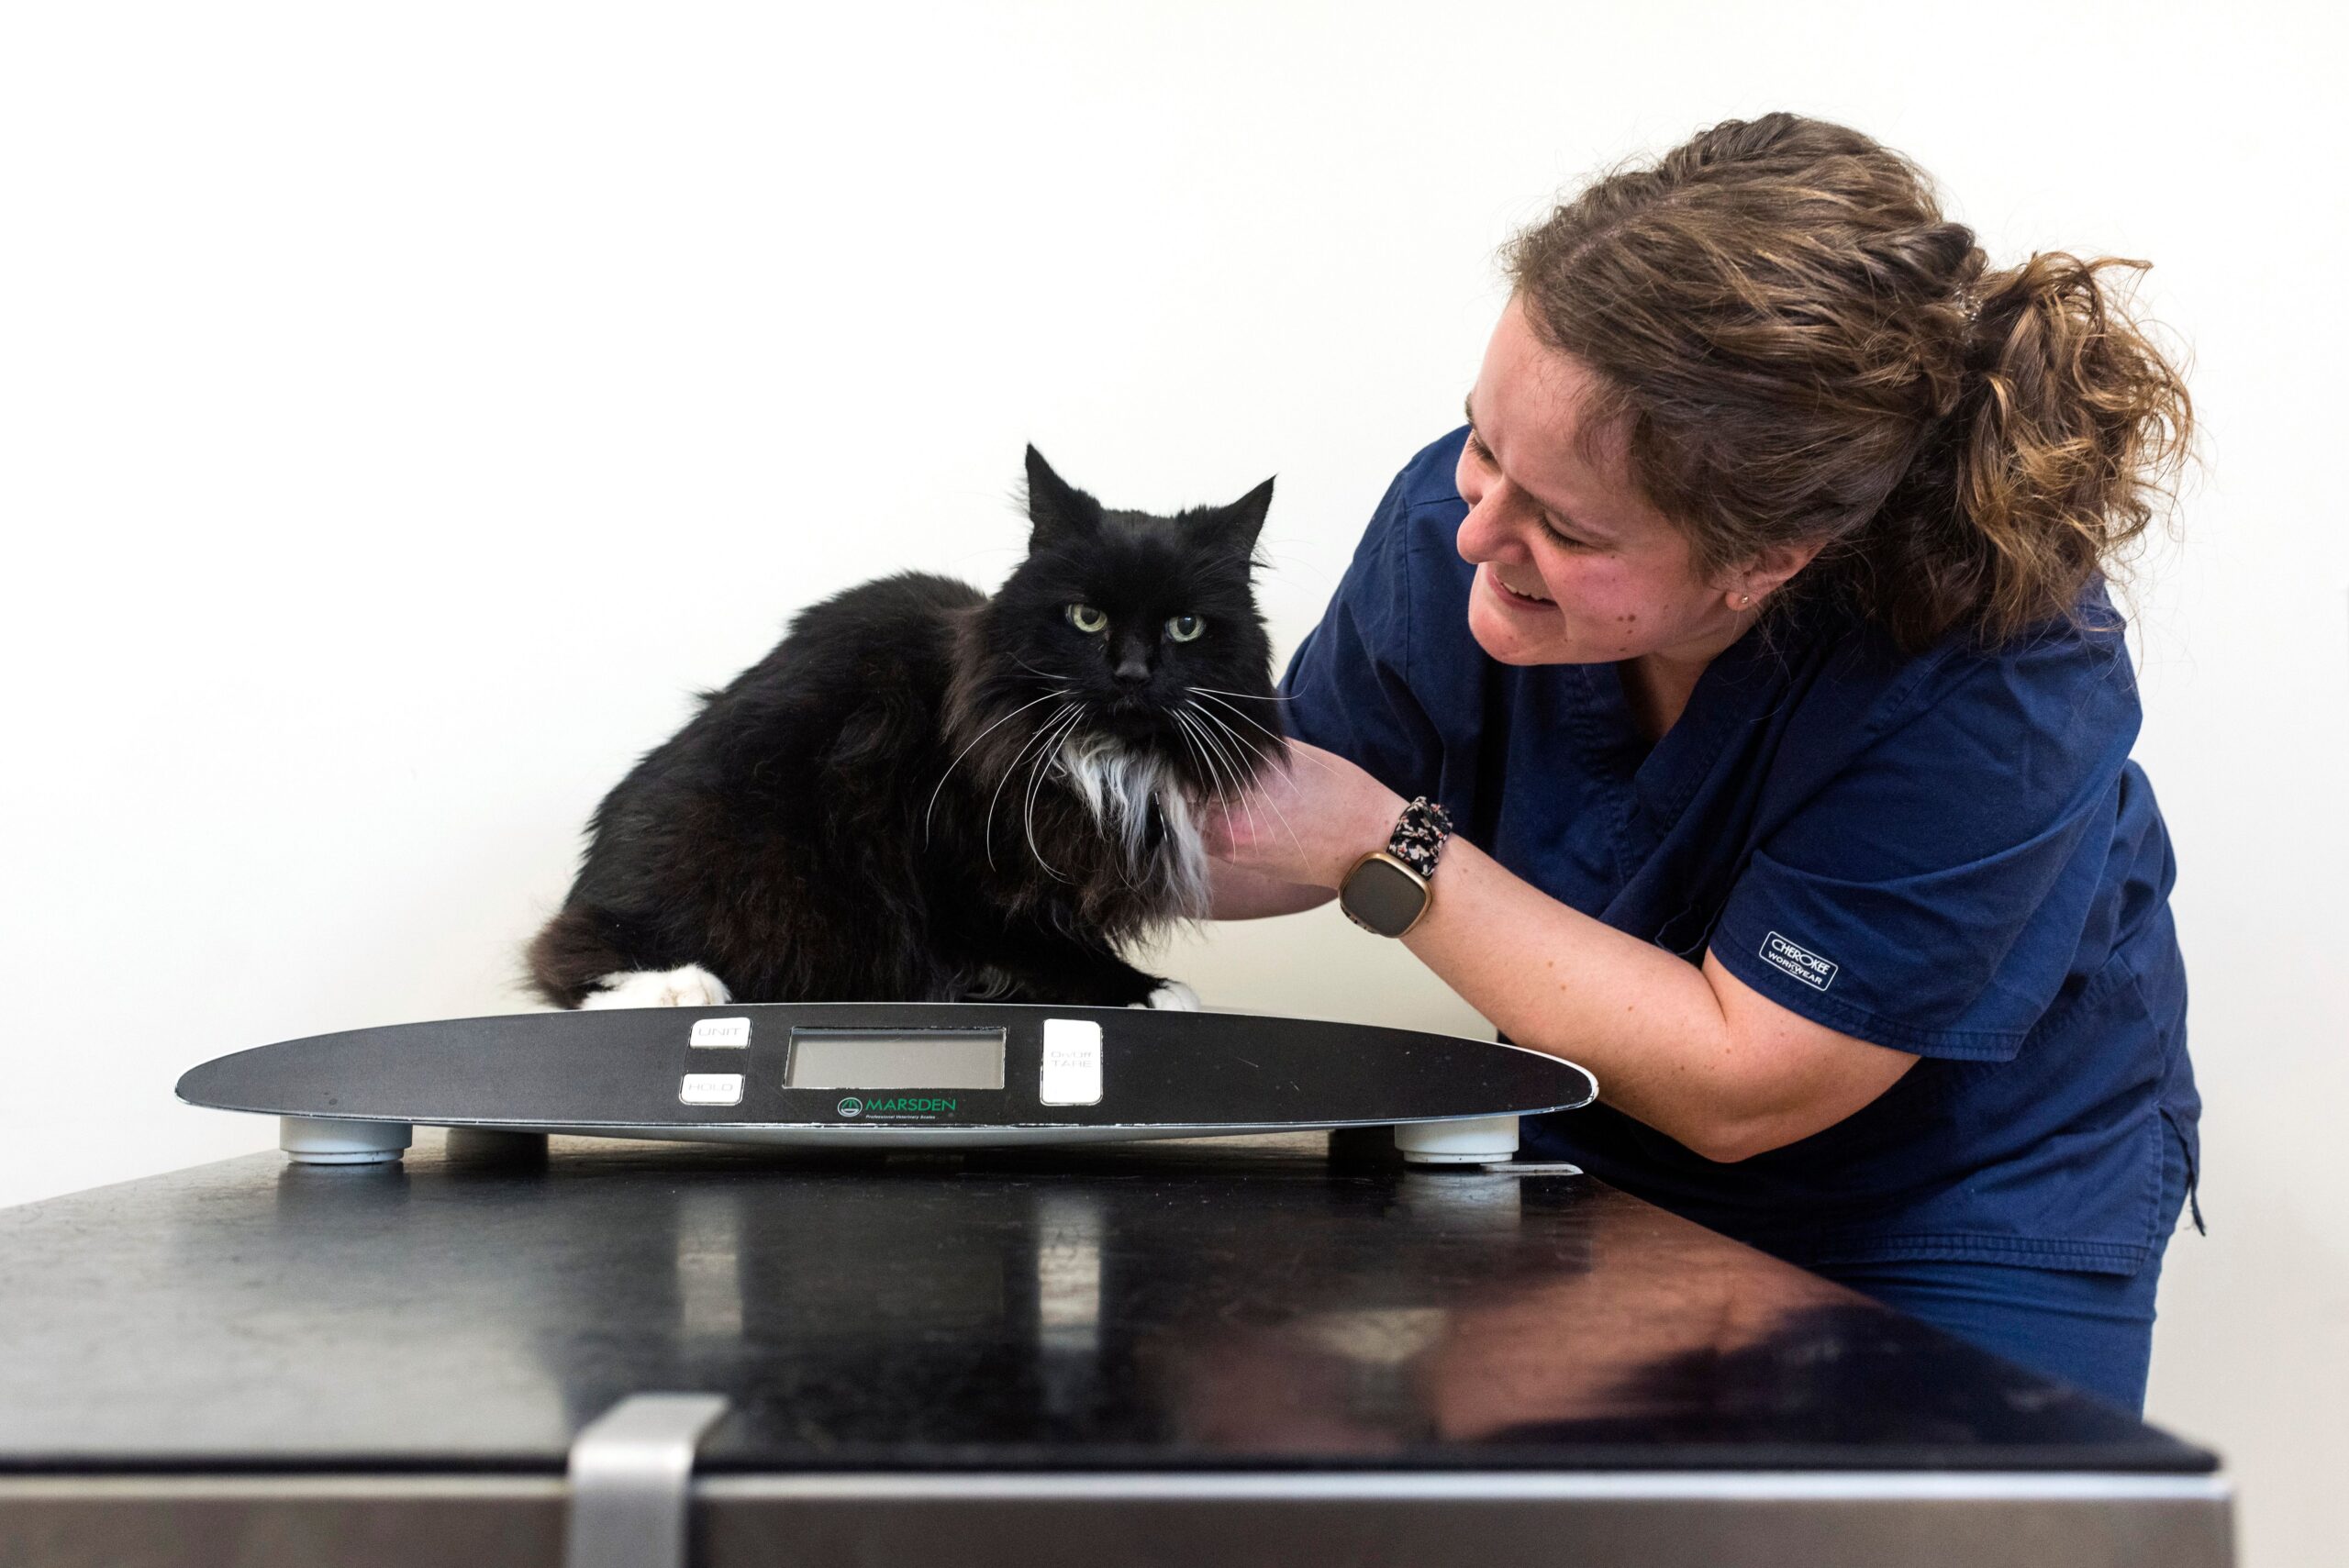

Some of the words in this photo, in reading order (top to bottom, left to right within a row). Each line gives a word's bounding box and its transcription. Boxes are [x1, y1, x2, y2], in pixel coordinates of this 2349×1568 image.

[1771, 939, 1831, 975] CHEROKEE
[1768, 951, 1823, 984] WORKWEAR
[697, 1028, 741, 1037] UNIT
[688, 1083, 733, 1092] HOLD
[865, 1098, 956, 1111] MARSDEN
